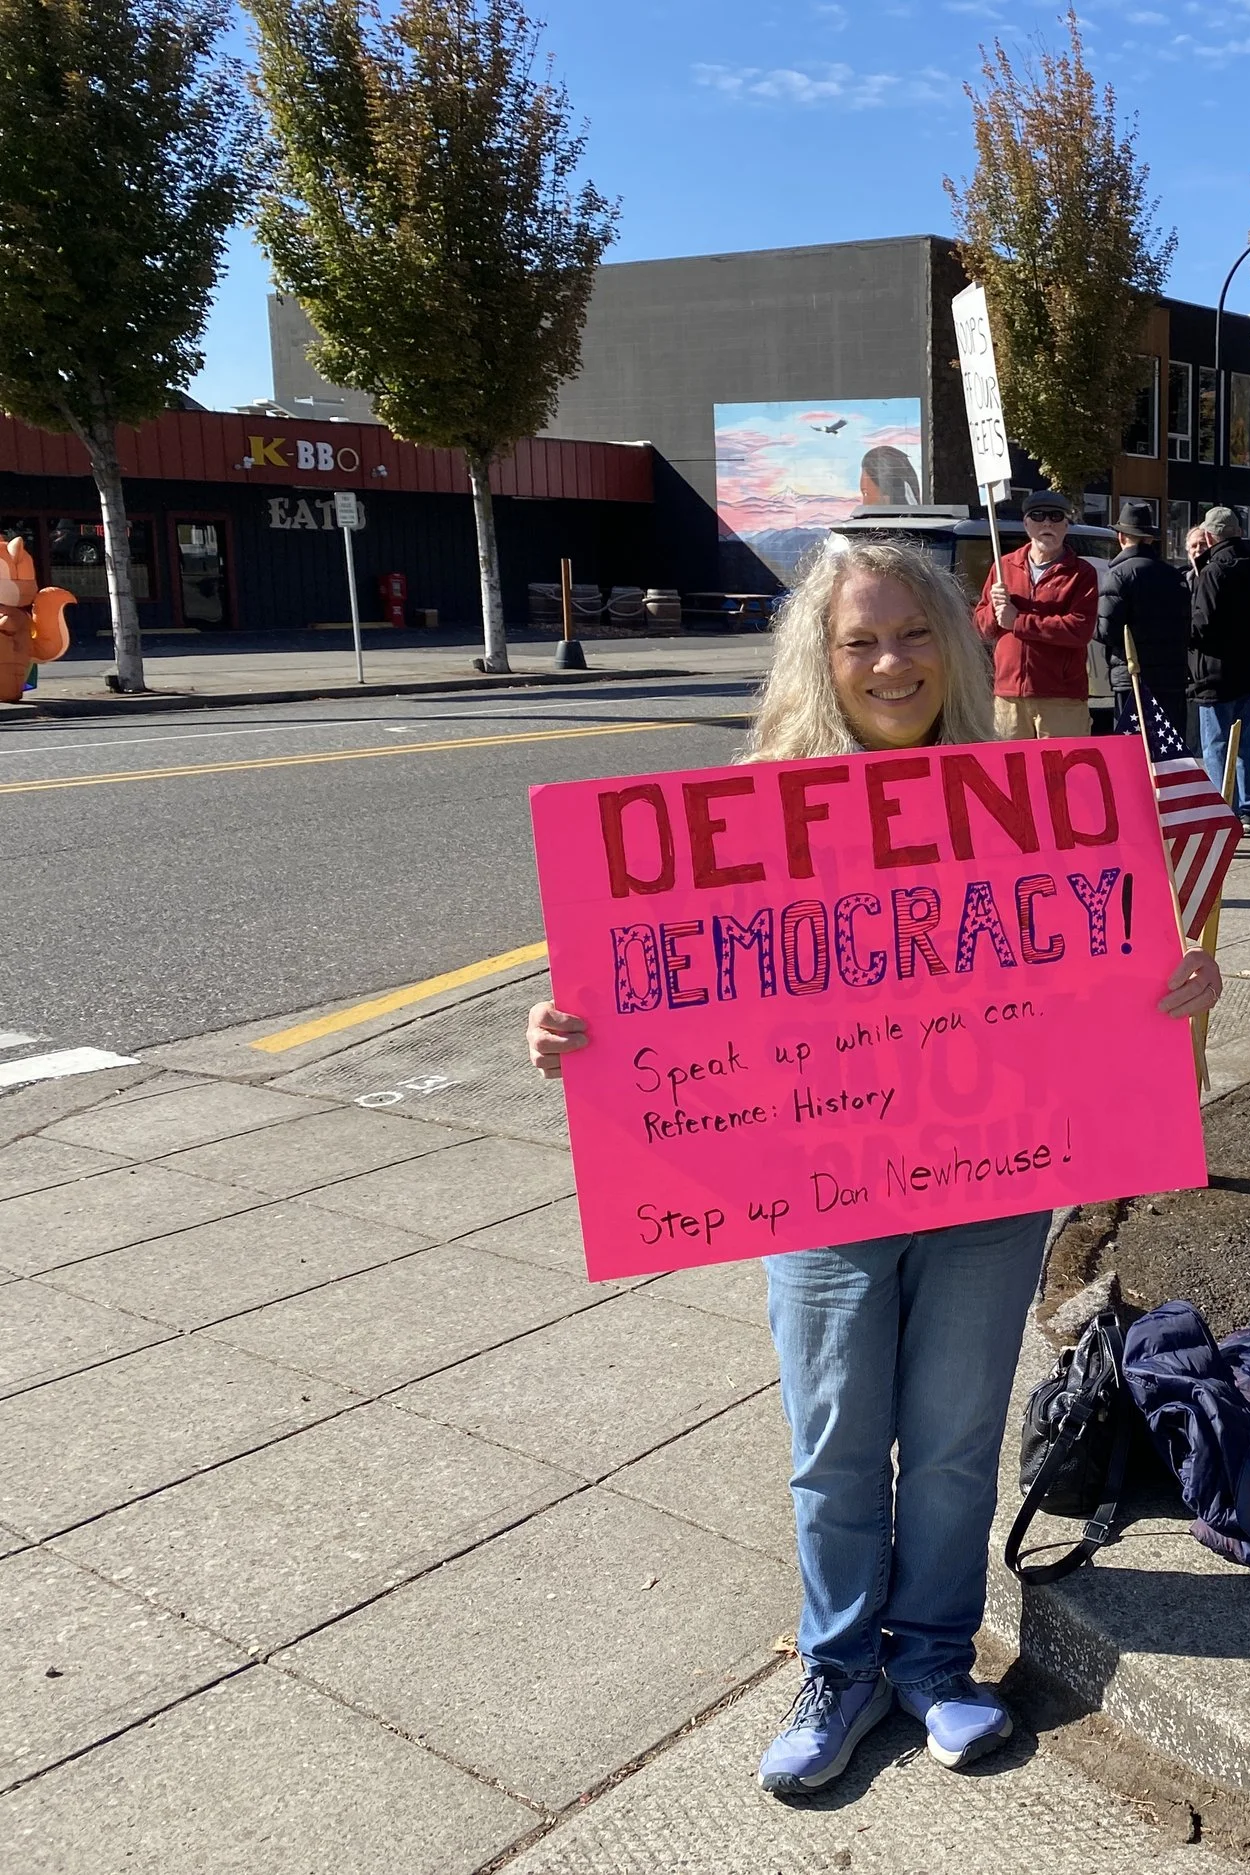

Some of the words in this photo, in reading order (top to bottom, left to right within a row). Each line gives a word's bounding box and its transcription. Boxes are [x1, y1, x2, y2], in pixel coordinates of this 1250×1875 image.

[267, 497, 366, 531] EAT
[597, 747, 1120, 898] DEFEND
[608, 867, 1133, 1015] DEMOCRACY!
[633, 1041, 746, 1103] Speak
[775, 1042, 811, 1074] up
[835, 1016, 904, 1053] while
[919, 1012, 967, 1050] you
[984, 1000, 1045, 1025] can.
[643, 1101, 779, 1145] Reference:
[793, 1085, 896, 1124] History
[637, 1203, 725, 1247] Step
[747, 1199, 790, 1237] up
[809, 1171, 869, 1213] Dan
